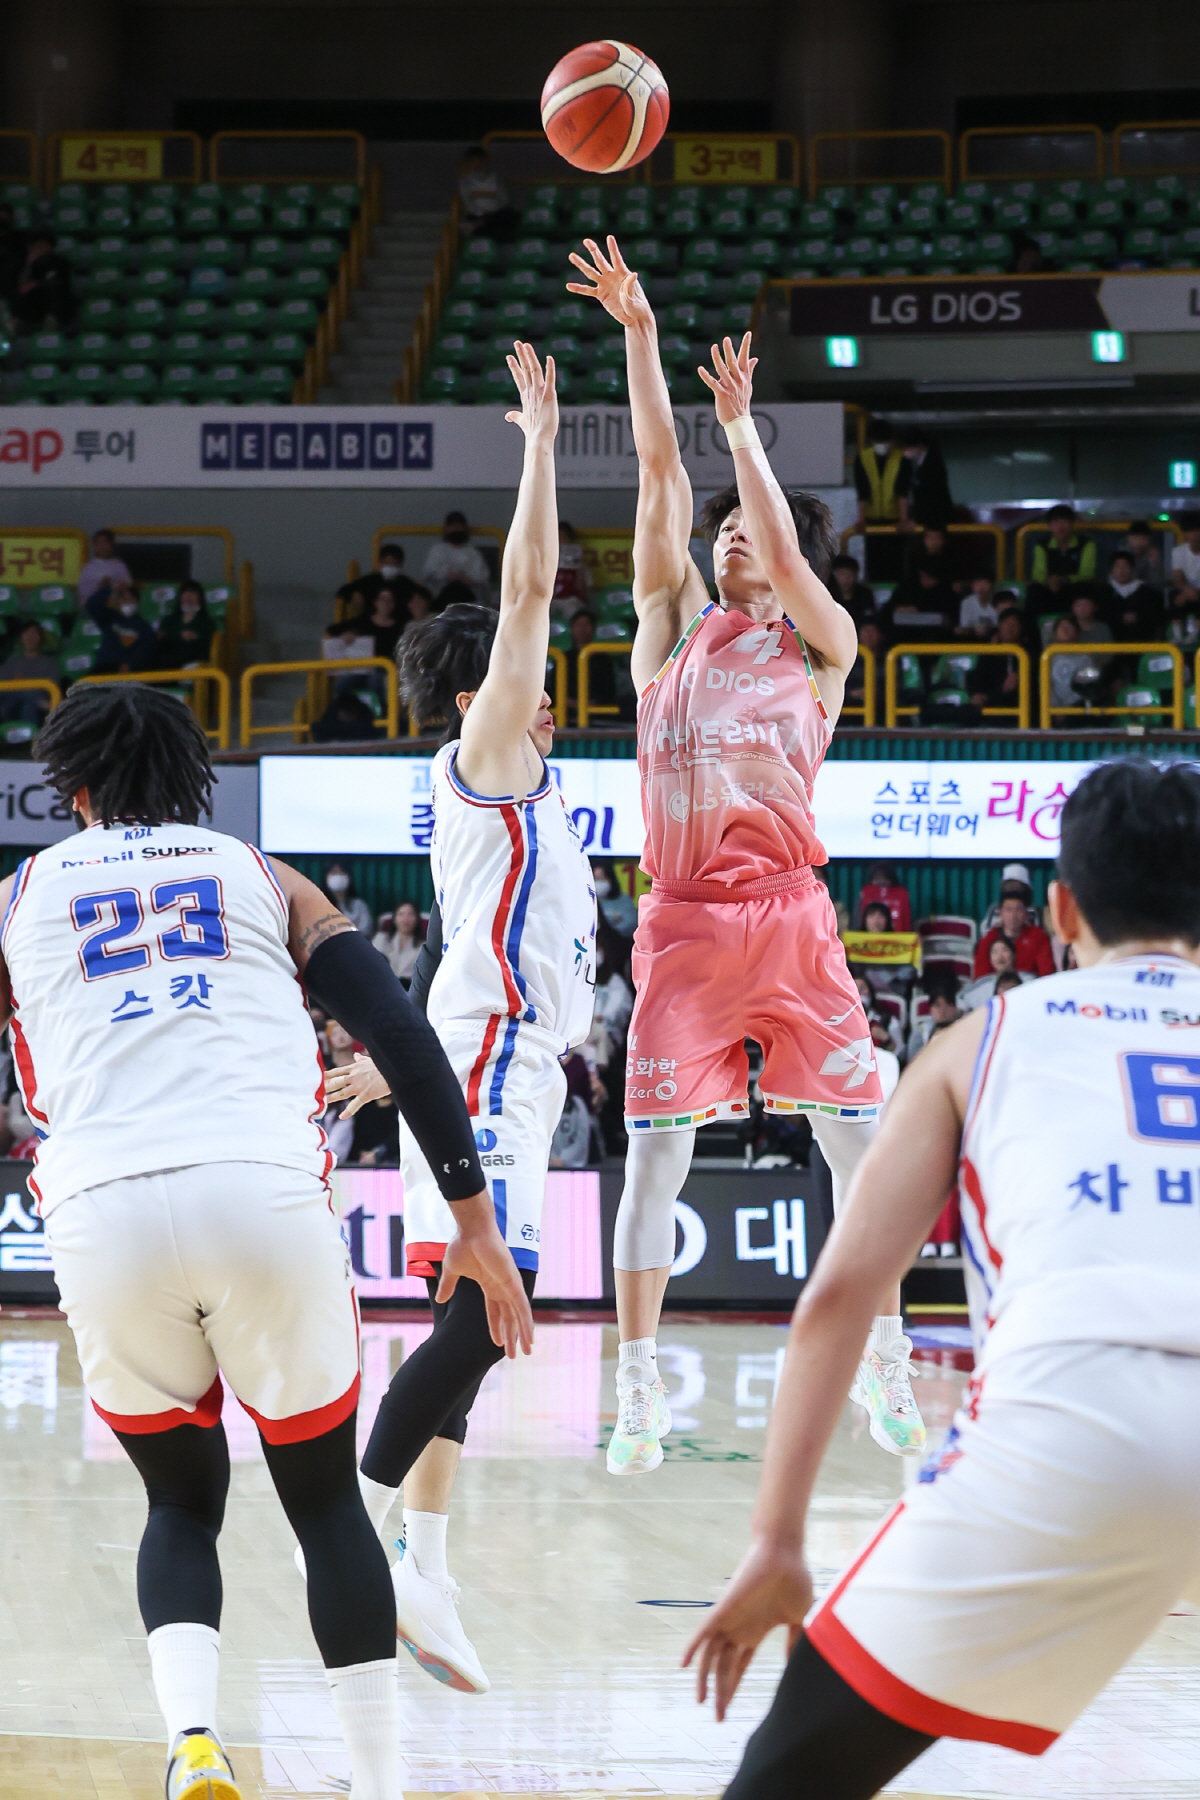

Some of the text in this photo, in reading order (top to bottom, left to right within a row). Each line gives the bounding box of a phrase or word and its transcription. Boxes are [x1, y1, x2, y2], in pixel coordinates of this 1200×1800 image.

[77, 143, 148, 173] 4구역
[689, 143, 762, 177] 3구역
[869, 290, 1023, 325] LG DIOS
[0, 427, 136, 475] ap 투어
[204, 428, 430, 465] MEGABOX
[559, 411, 636, 458] HAN
[731, 629, 786, 666] 4
[705, 667, 776, 697] DIOS
[873, 779, 962, 805] 스포츠
[870, 813, 980, 839] 언더웨어
[61, 845, 220, 869] Mobil Super
[69, 875, 231, 983] 23
[1046, 1000, 1147, 1022] Mobil
[626, 1056, 680, 1079] G화학
[818, 1036, 877, 1092] 4
